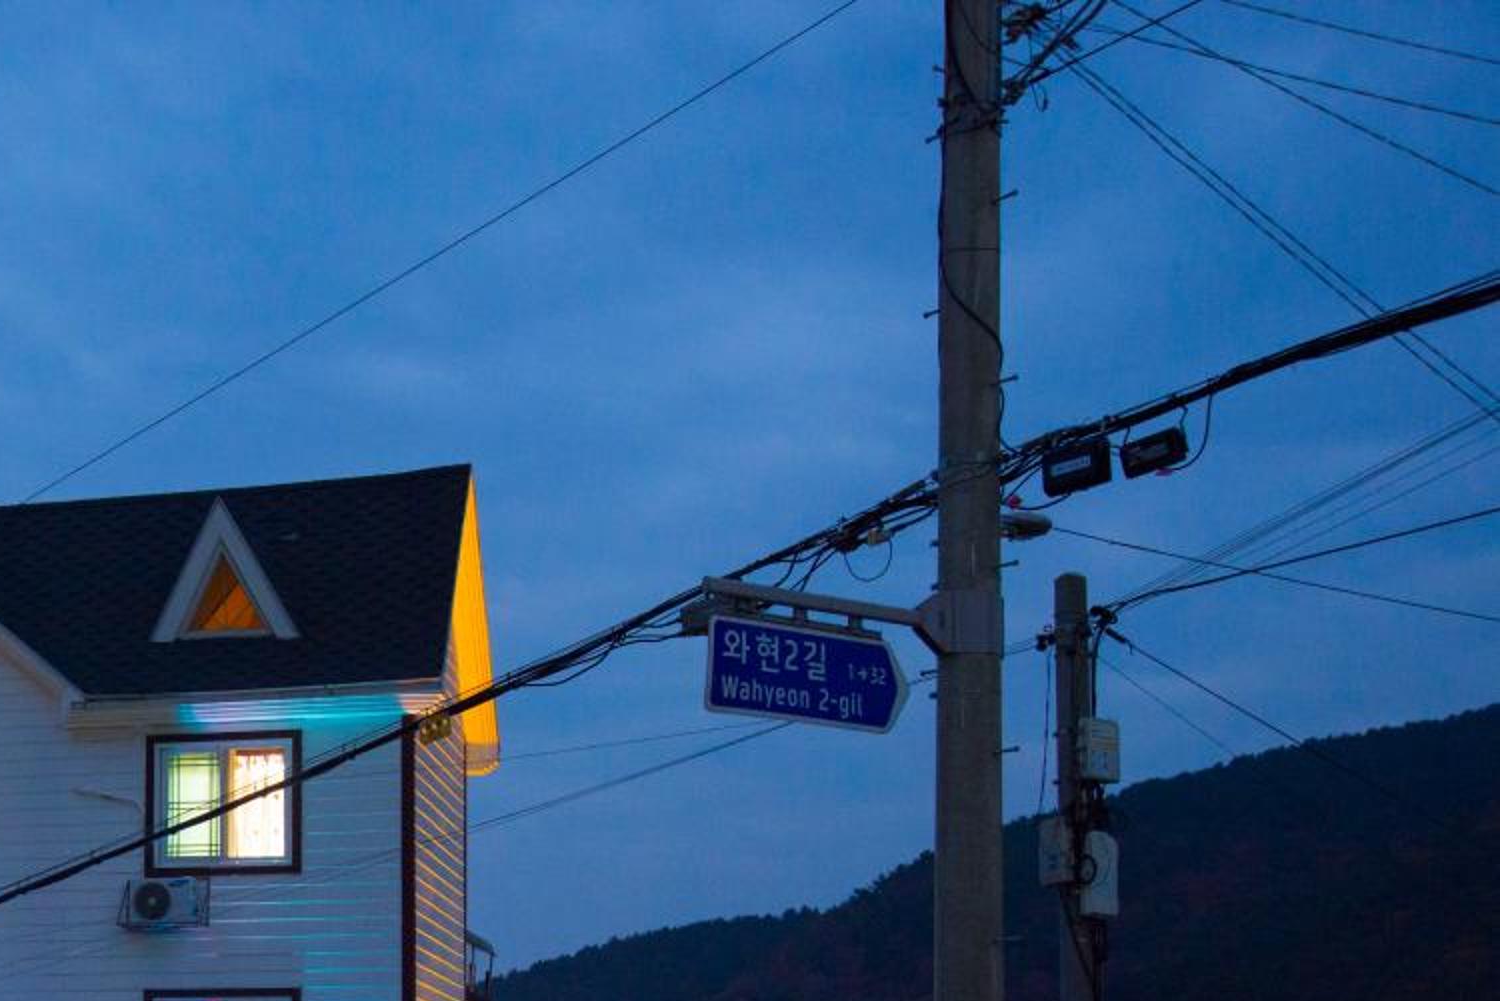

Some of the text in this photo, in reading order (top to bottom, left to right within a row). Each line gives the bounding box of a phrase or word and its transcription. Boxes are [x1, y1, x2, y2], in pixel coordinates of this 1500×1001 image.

[722, 629, 827, 681] 와현2길
[721, 675, 864, 719] Wahyeon 2-gil
